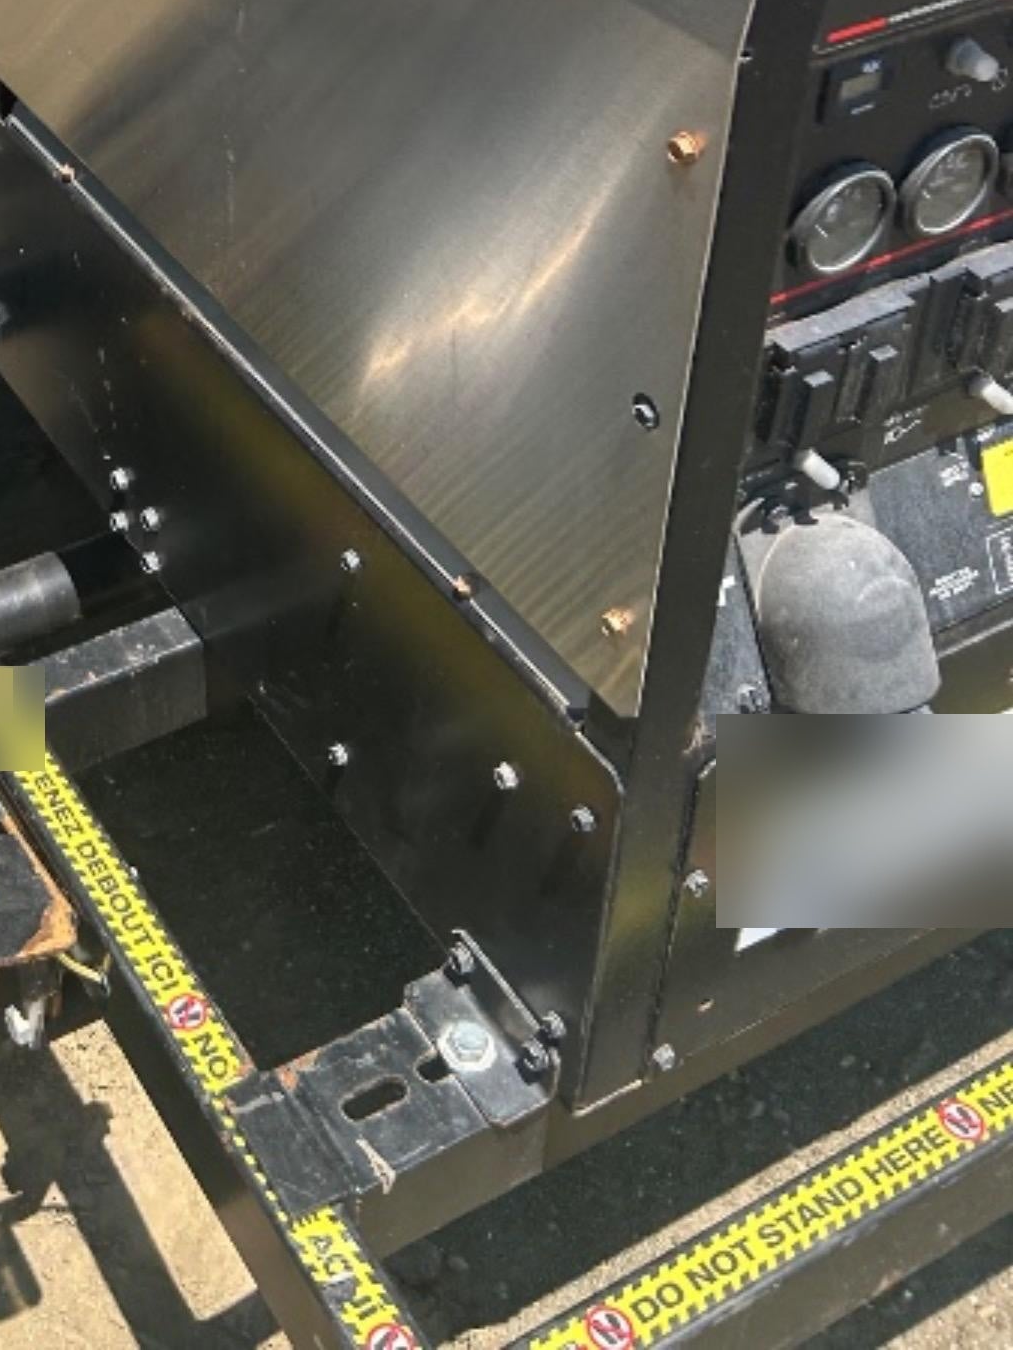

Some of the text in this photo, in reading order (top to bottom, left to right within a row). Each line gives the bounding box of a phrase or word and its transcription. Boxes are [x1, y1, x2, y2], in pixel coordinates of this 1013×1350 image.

[33, 772, 182, 993] ENEZ DEBOUT ICI
[191, 1030, 231, 1078] NO
[629, 1124, 951, 1324] DO NOT STAND HERE
